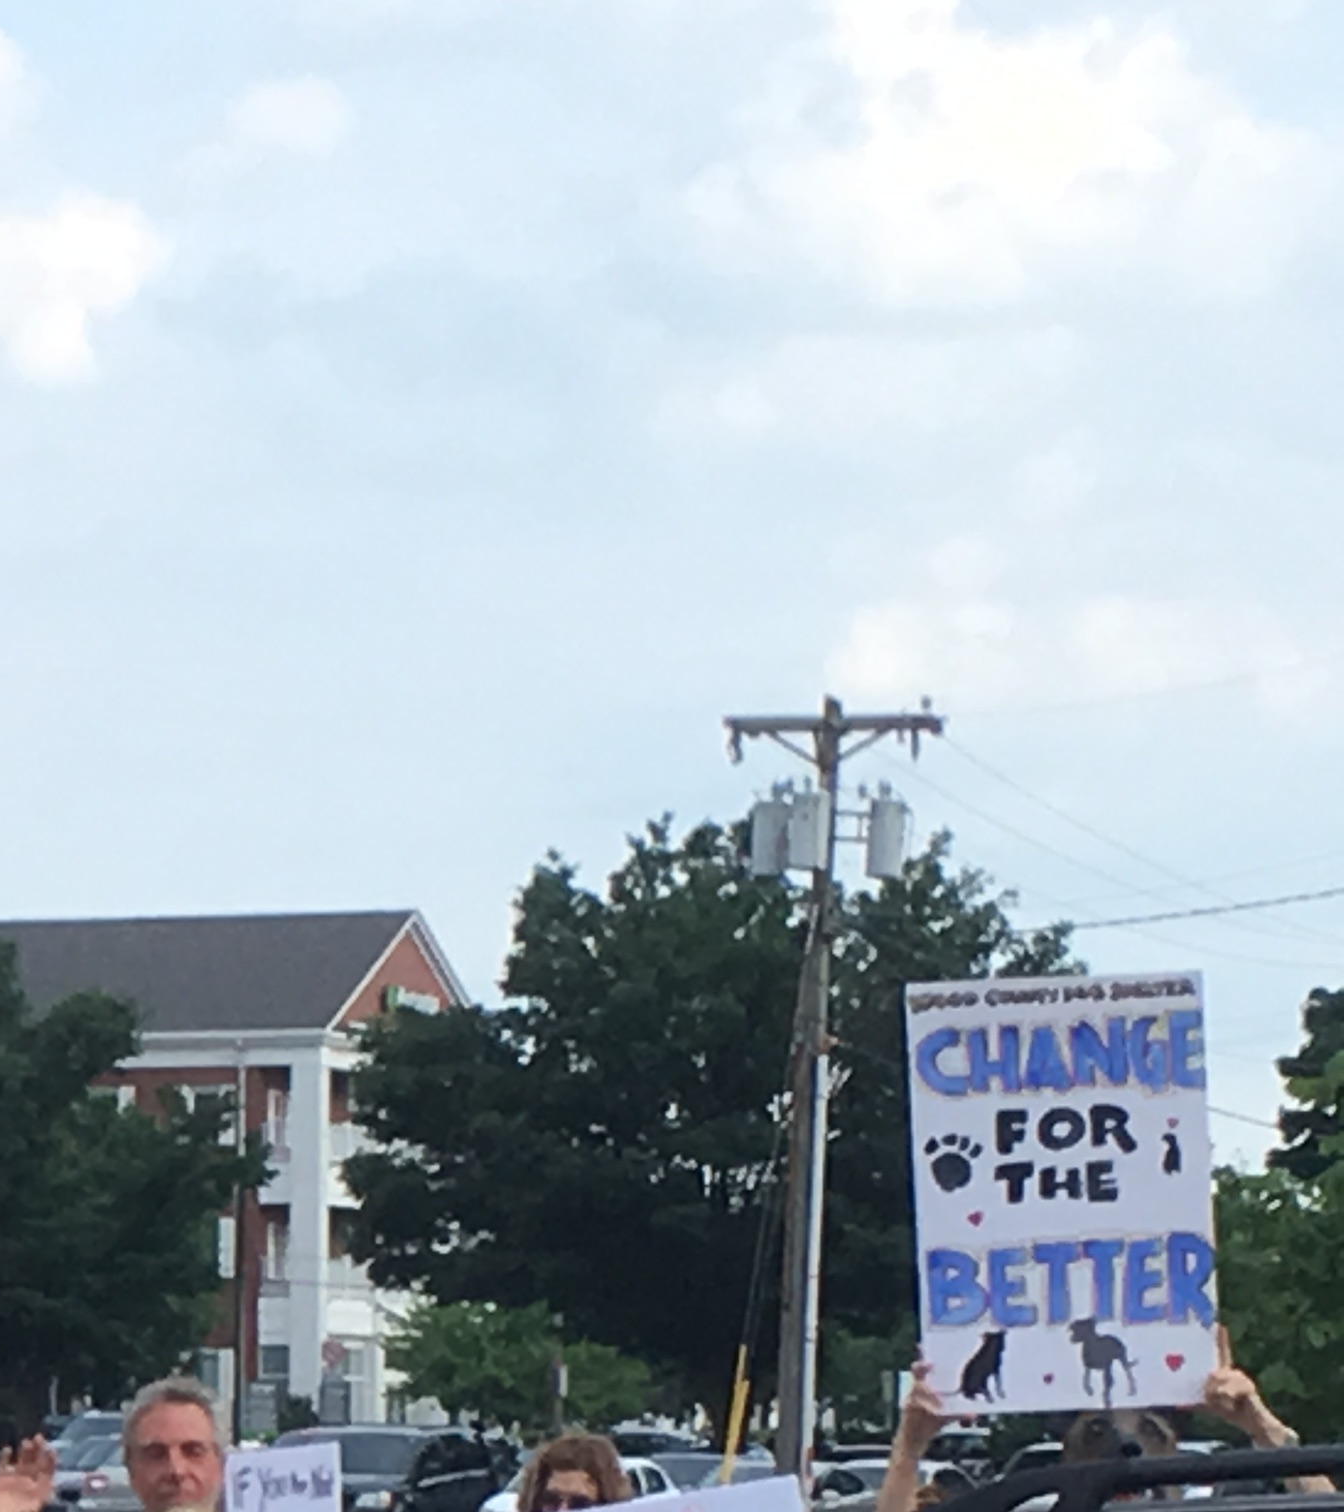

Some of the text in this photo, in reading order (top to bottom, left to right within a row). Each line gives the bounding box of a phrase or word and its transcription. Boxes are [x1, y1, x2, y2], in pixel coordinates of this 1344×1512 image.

[915, 1008, 1206, 1096] CHANGE
[996, 1103, 1137, 1155] FOR
[994, 1160, 1119, 1204] THE
[925, 1230, 1216, 1330] BETTER
